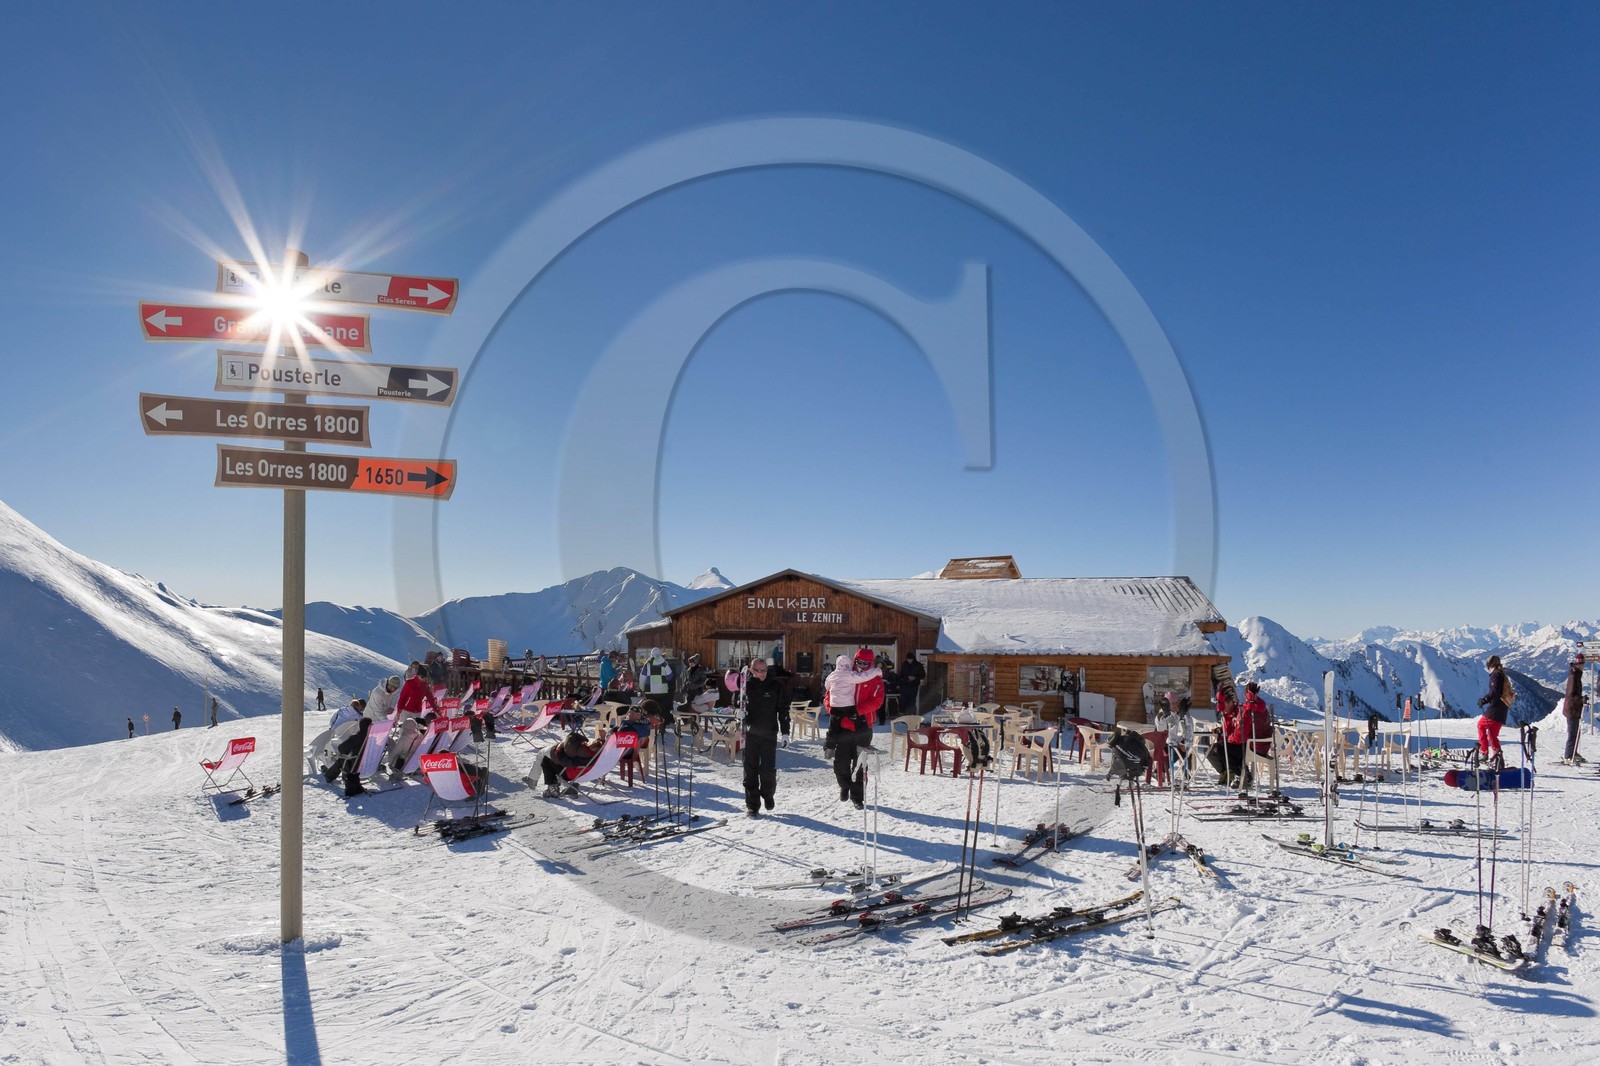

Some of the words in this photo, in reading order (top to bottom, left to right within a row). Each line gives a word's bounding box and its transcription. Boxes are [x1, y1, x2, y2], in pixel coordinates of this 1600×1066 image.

[248, 363, 341, 386] Pousterle
[379, 388, 411, 397] Pousterle
[216, 409, 248, 428] Les
[254, 411, 307, 431] Orres
[314, 415, 359, 434] 1800
[225, 456, 253, 476] Les
[258, 459, 303, 479] Orres
[309, 462, 347, 482] 1800
[365, 466, 404, 486] 1650
[797, 612, 807, 622] LE
[812, 612, 843, 624] ZENITH
